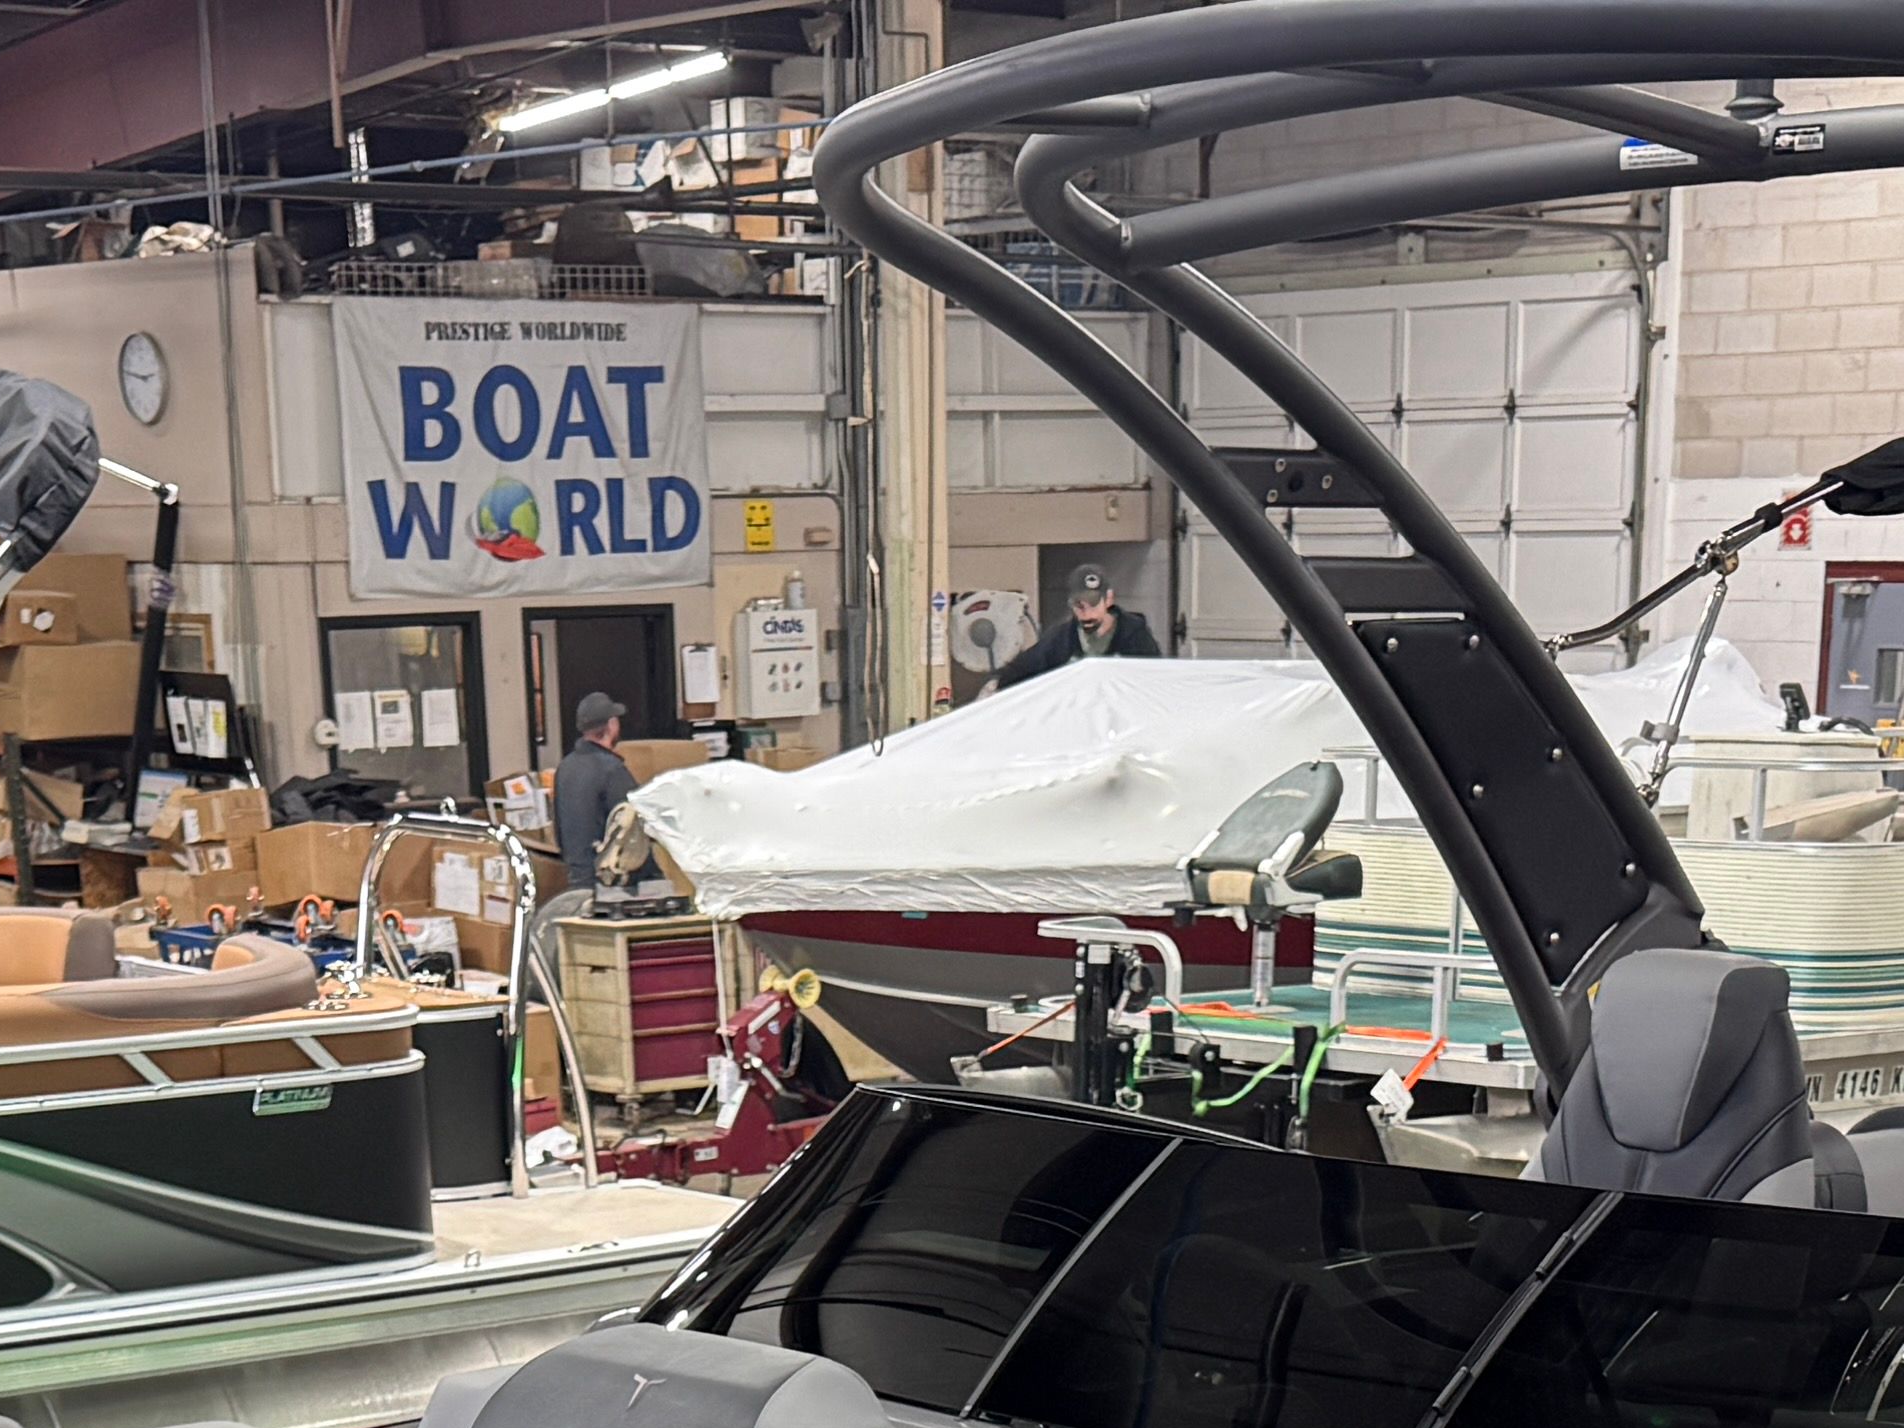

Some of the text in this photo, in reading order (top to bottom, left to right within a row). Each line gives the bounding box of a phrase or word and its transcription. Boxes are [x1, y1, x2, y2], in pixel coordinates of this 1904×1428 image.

[424, 321, 628, 342] PRESTIGE WORLDWIDE
[398, 364, 666, 463] BOAT
[1836, 1069, 1880, 1099] 4146
